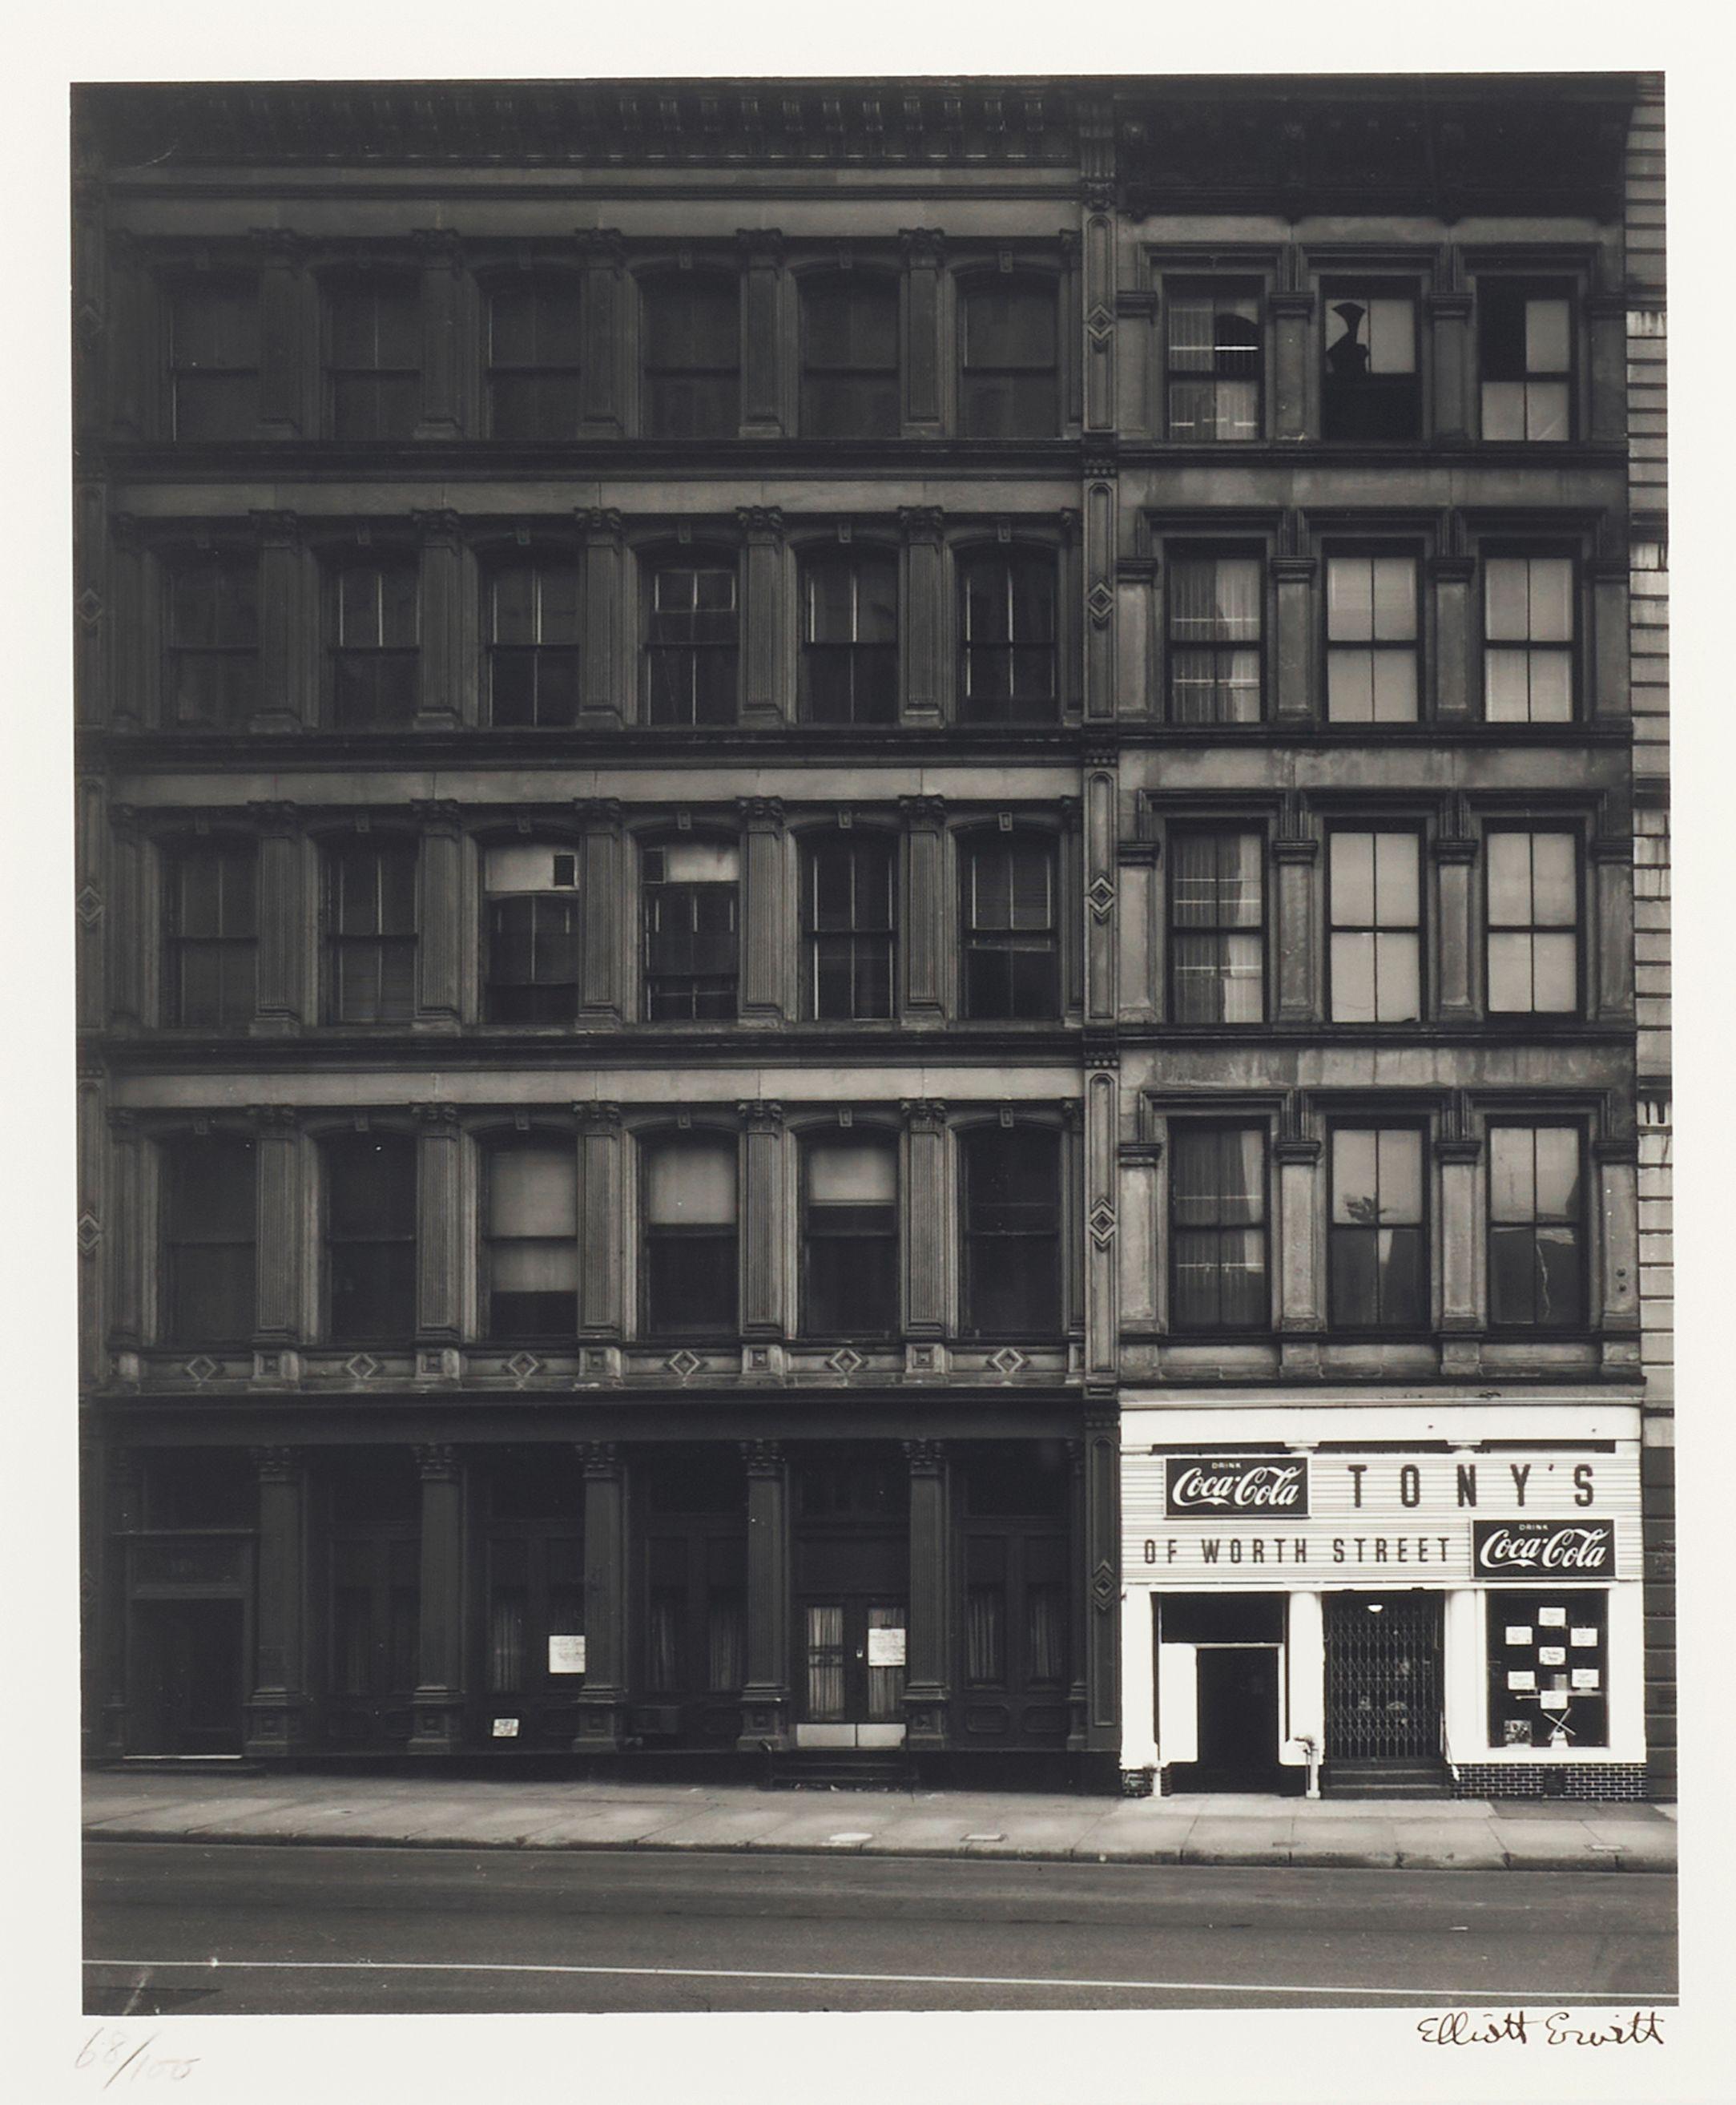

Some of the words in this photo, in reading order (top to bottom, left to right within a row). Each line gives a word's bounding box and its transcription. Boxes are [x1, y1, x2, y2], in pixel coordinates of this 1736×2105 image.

[1172, 1466, 1304, 1506] Coca-Cola
[1347, 1463, 1593, 1508] TONY'S
[1144, 1538, 1177, 1564] OF
[1202, 1538, 1307, 1564] WORTH
[1333, 1538, 1450, 1563] STREET
[1480, 1528, 1611, 1568] Coca-Cola
